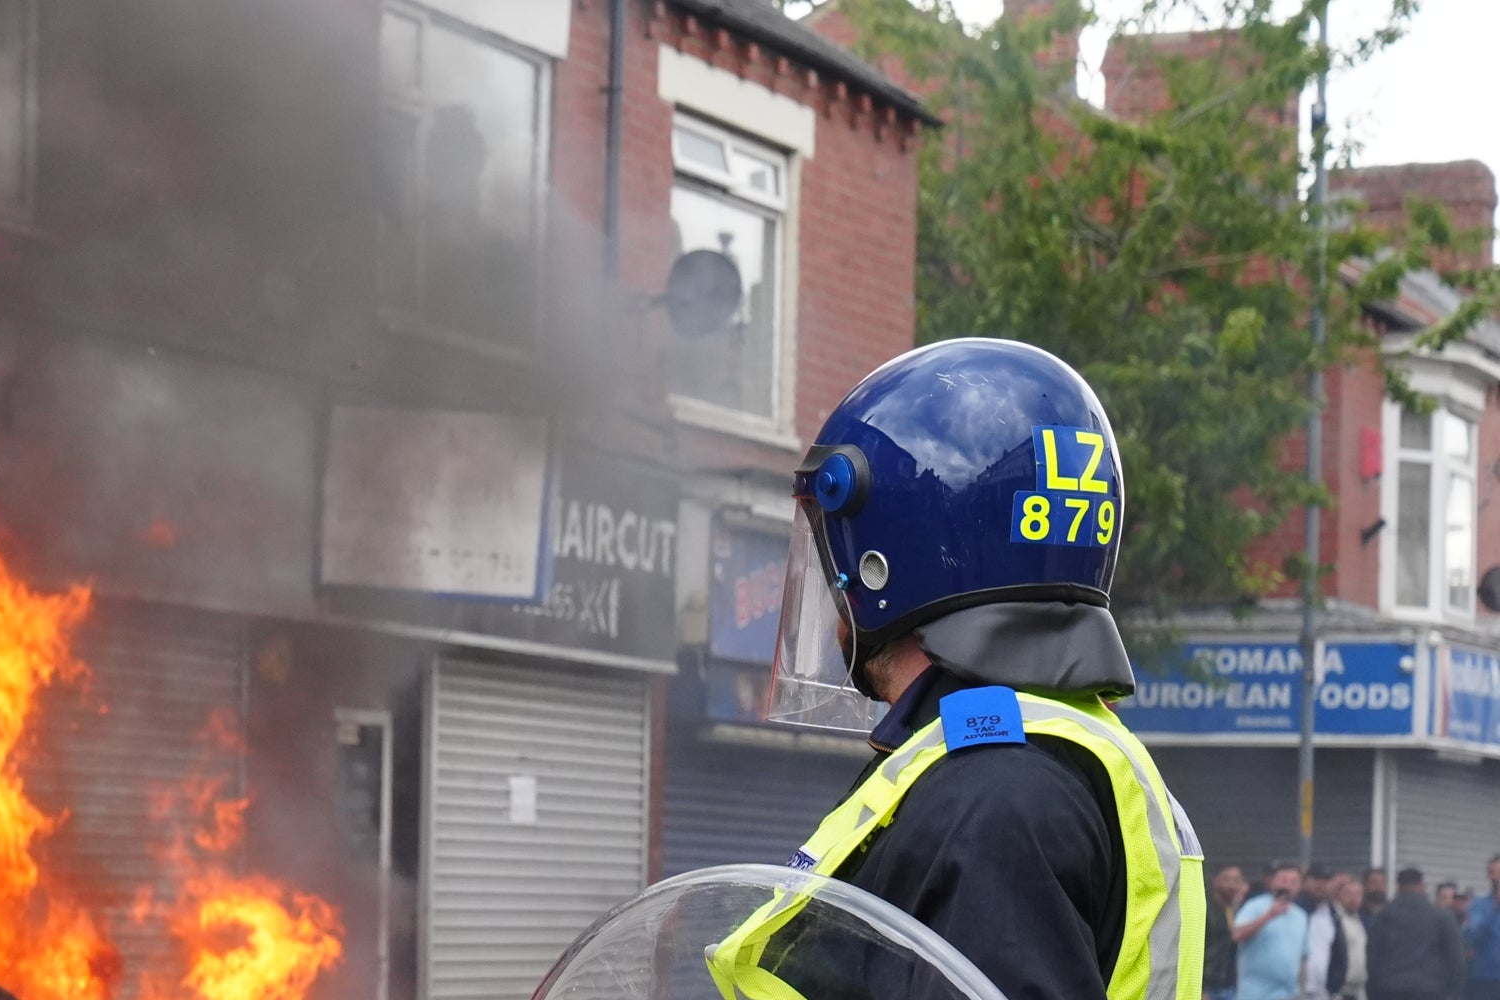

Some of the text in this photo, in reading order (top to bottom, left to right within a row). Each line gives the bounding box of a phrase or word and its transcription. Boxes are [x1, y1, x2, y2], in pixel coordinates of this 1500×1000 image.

[1042, 429, 1108, 494] LZ
[1020, 495, 1115, 545] 879
[1313, 681, 1411, 711] OODS
[966, 715, 1001, 728] 879
[974, 725, 996, 733] TAC
[963, 730, 1009, 740] ADVISOR
